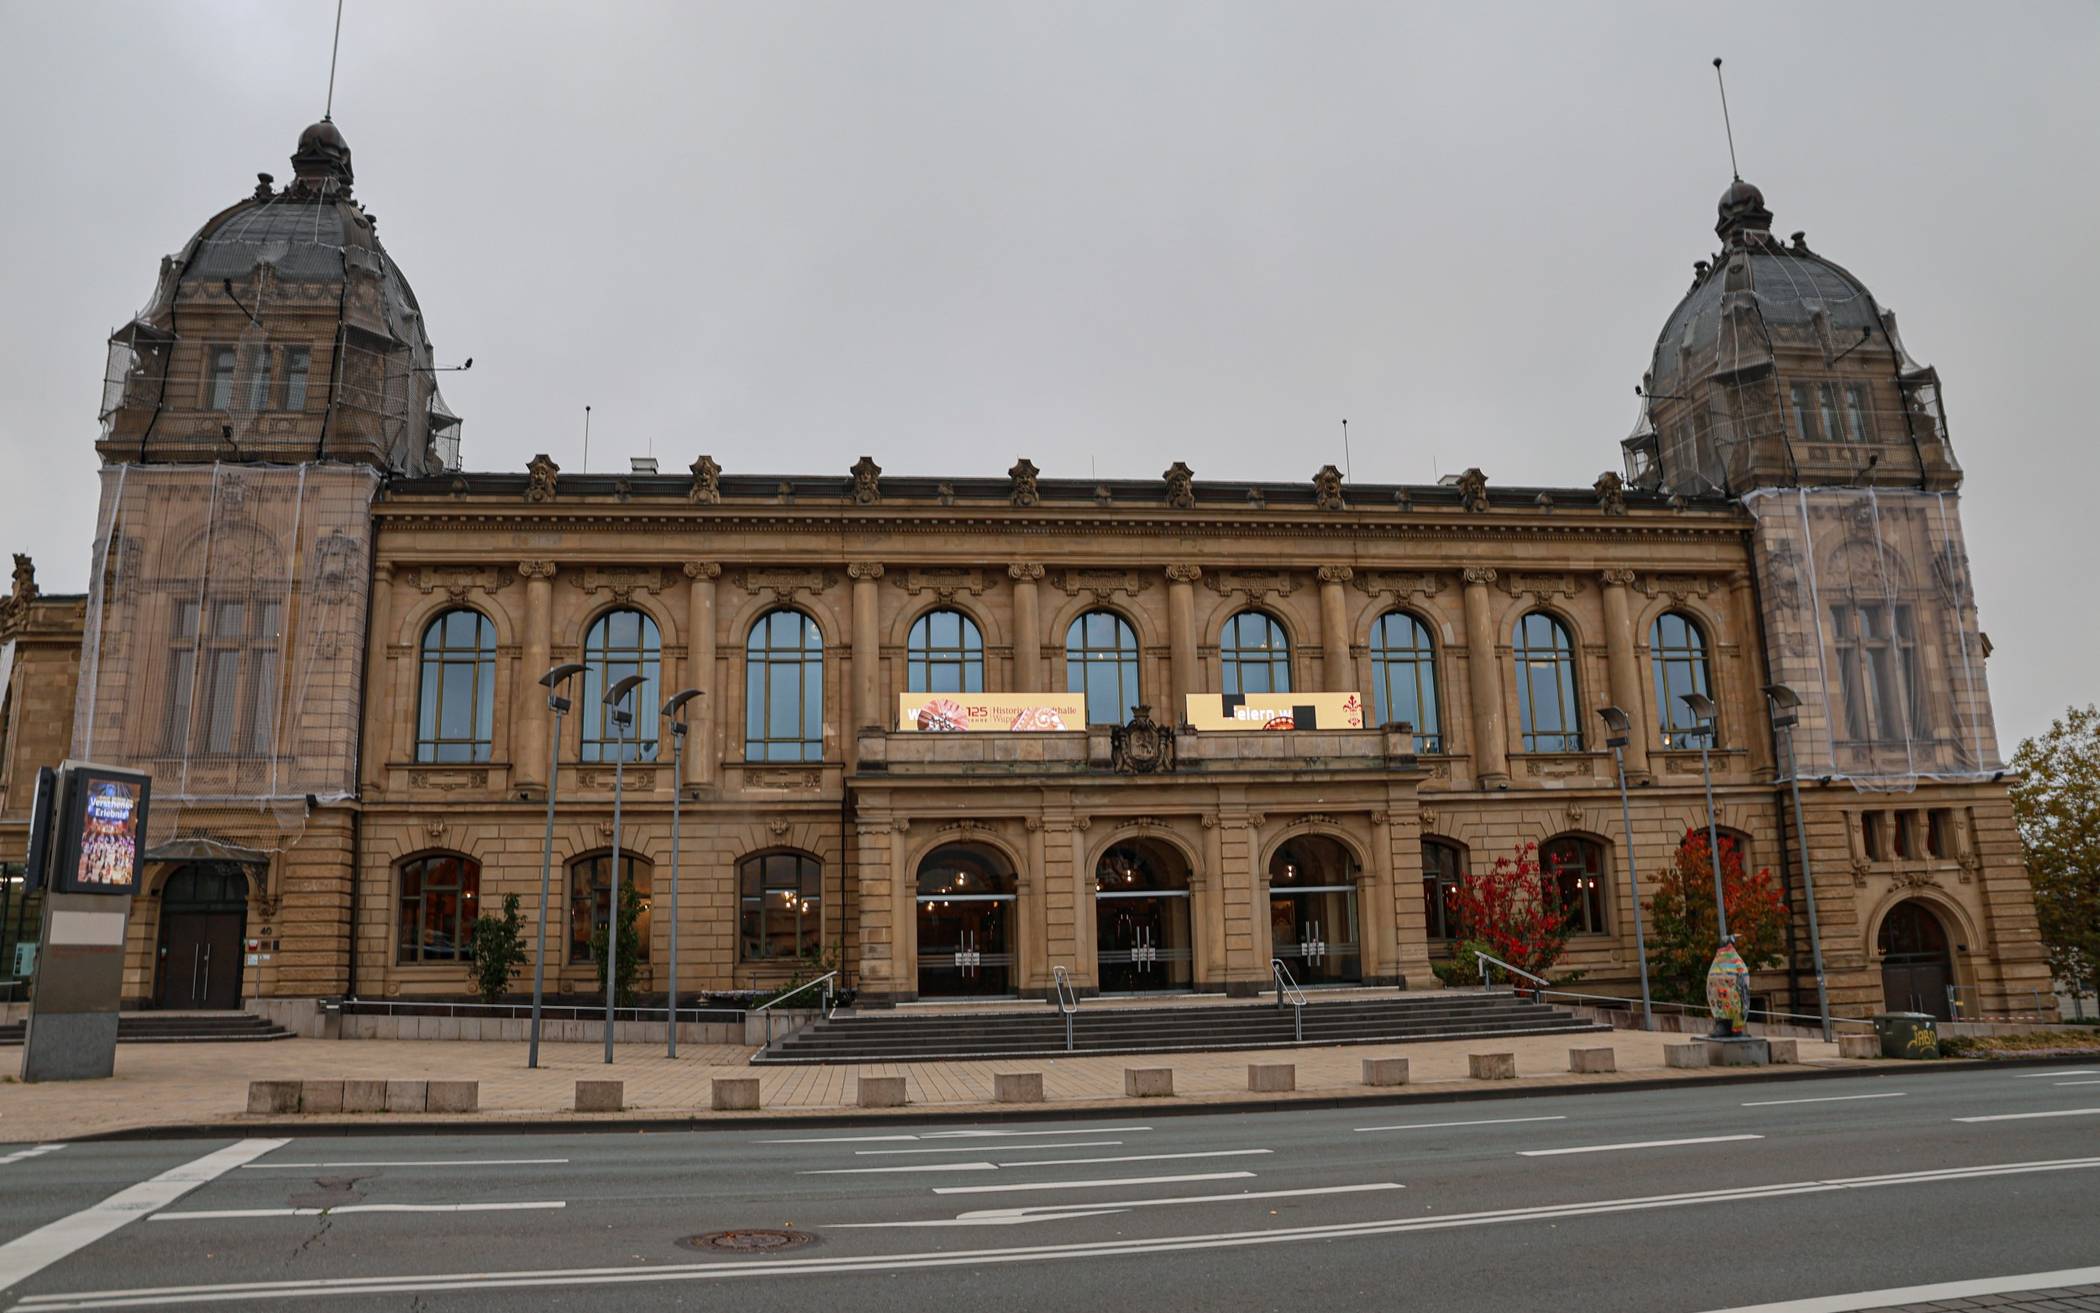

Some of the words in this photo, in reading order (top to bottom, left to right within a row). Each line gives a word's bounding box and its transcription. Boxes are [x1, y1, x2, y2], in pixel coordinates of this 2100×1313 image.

[965, 706, 988, 717] 125
[993, 706, 1024, 715] Historis
[260, 926, 272, 936] 40
